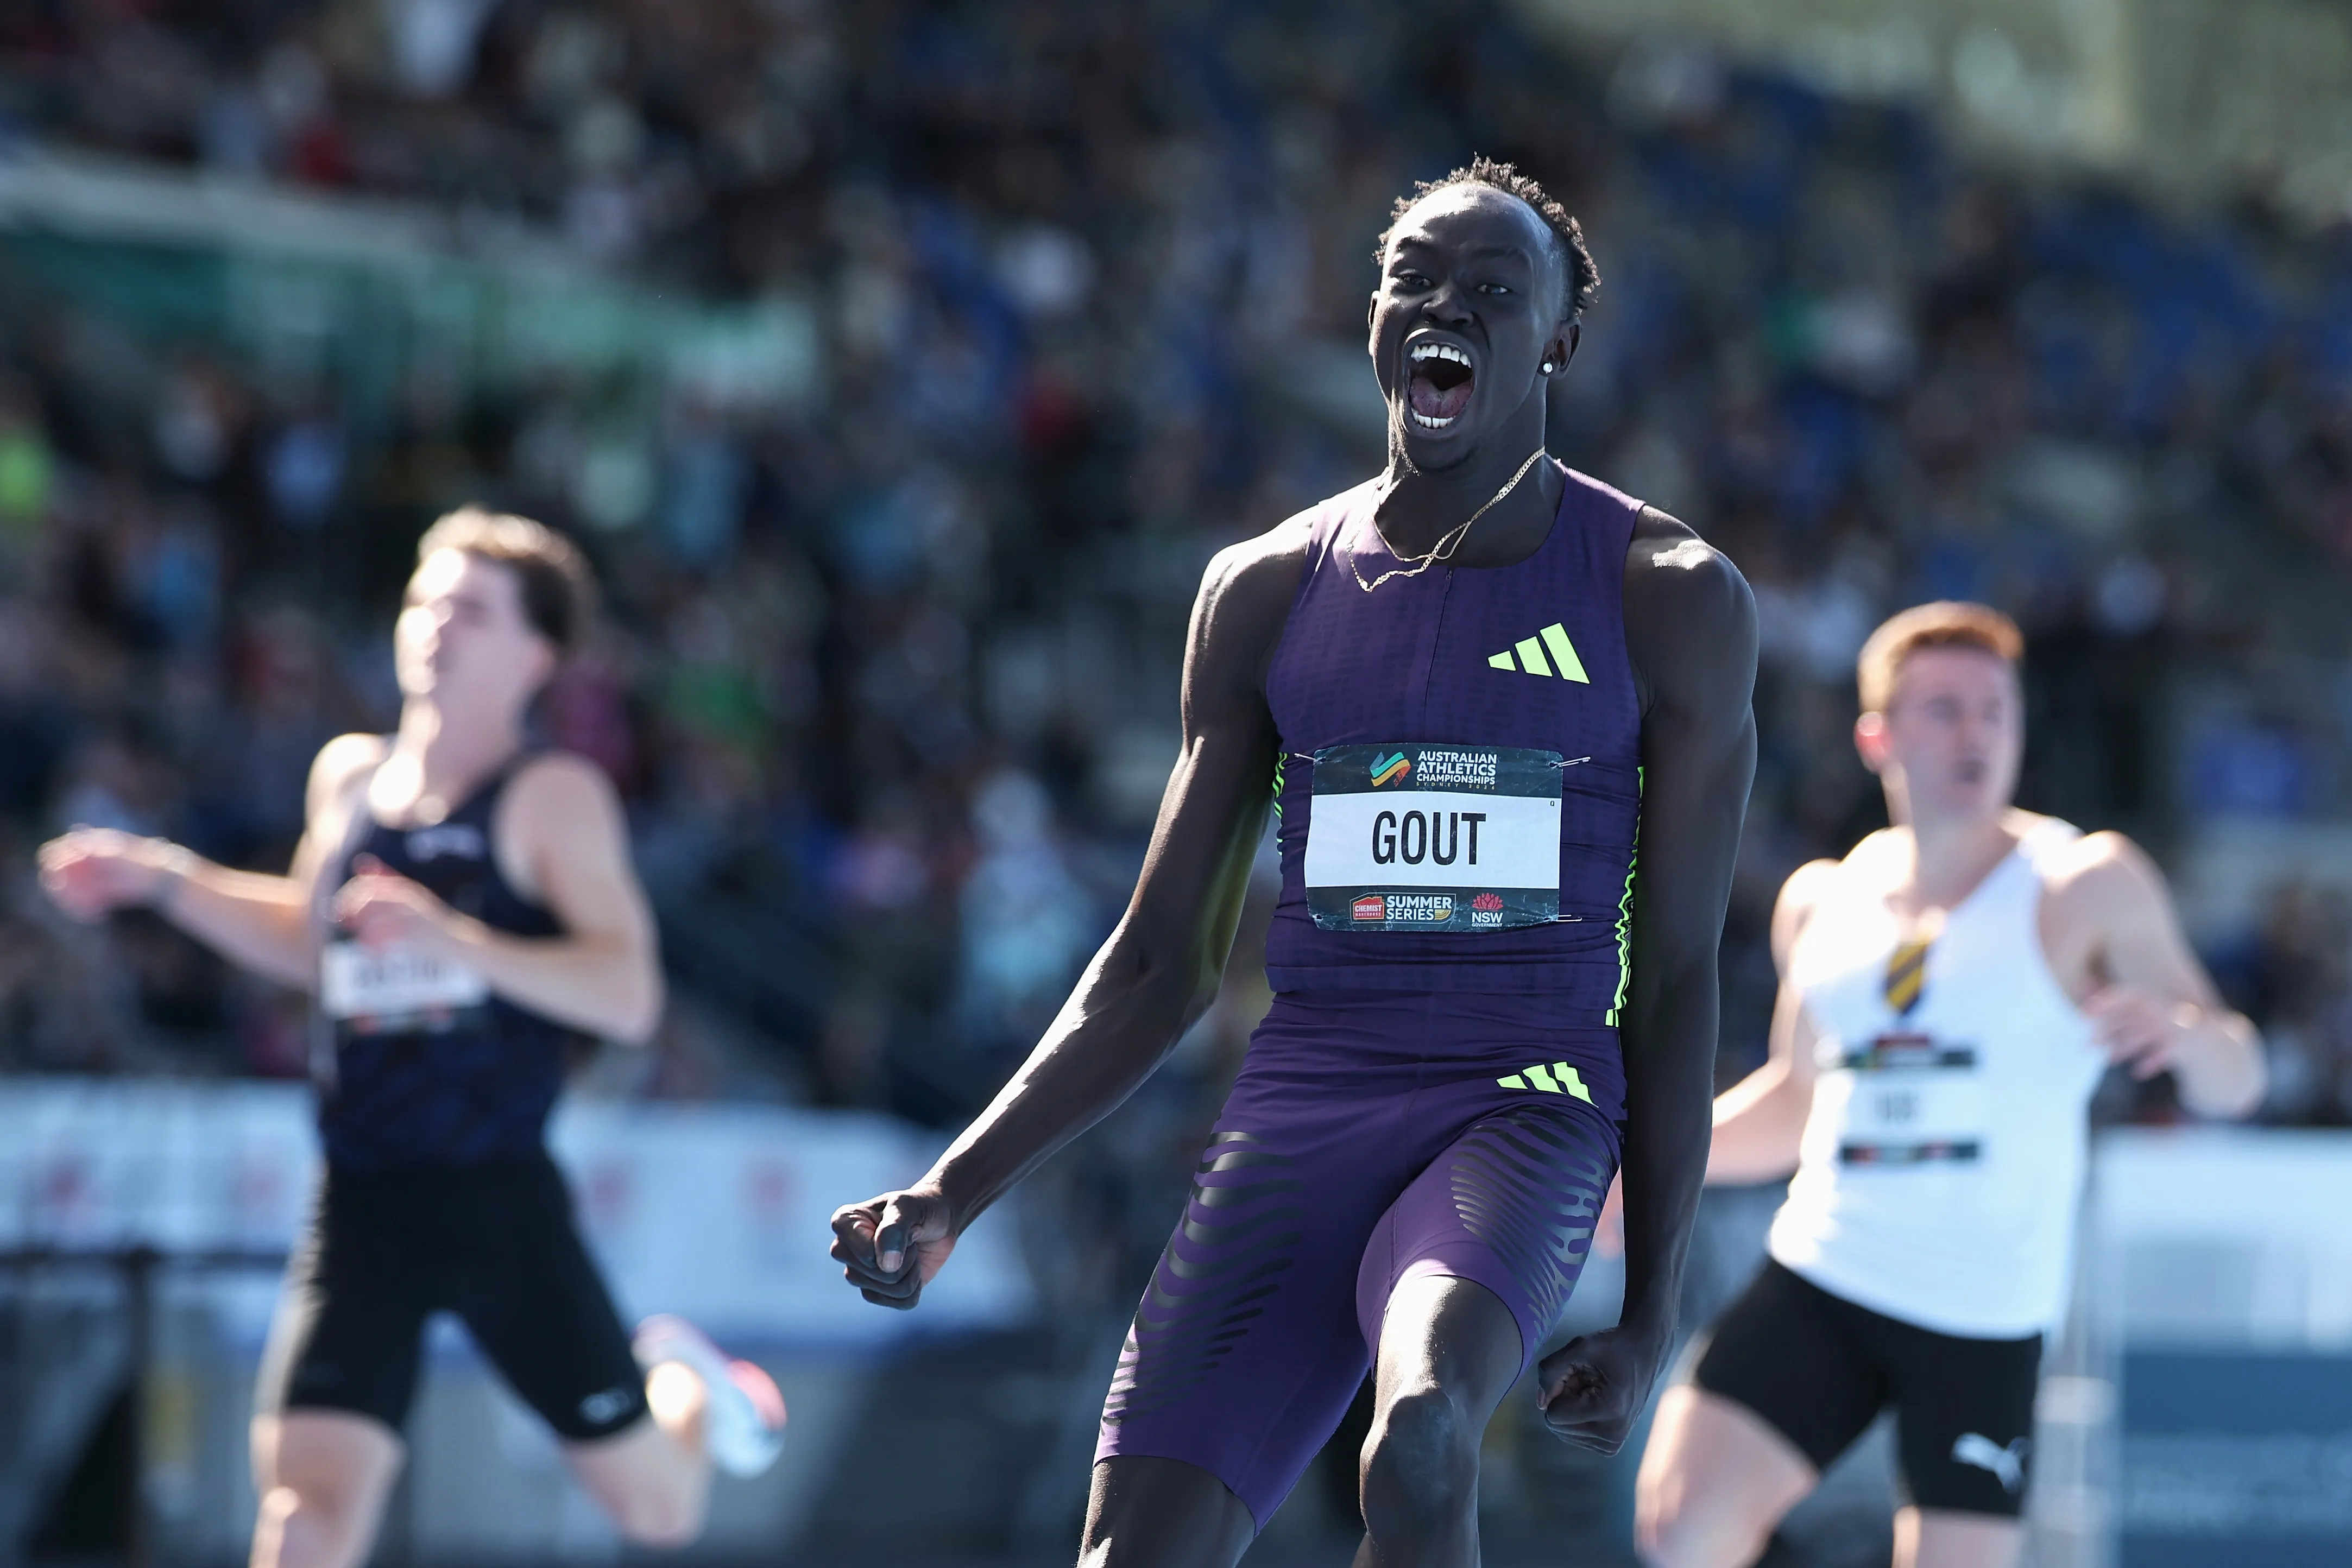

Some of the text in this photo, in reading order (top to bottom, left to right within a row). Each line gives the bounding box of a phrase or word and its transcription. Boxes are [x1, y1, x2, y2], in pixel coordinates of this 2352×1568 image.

[1417, 750, 1497, 764] AUSTRALIAN
[1417, 762, 1496, 776] ATHLETICS
[1416, 774, 1496, 785] CHAMPIONSHIPS
[1372, 811, 1486, 865] GOUT
[1386, 895, 1452, 909] SUMMER
[1386, 908, 1434, 921] SERIES
[1472, 912, 1503, 923] NSW
